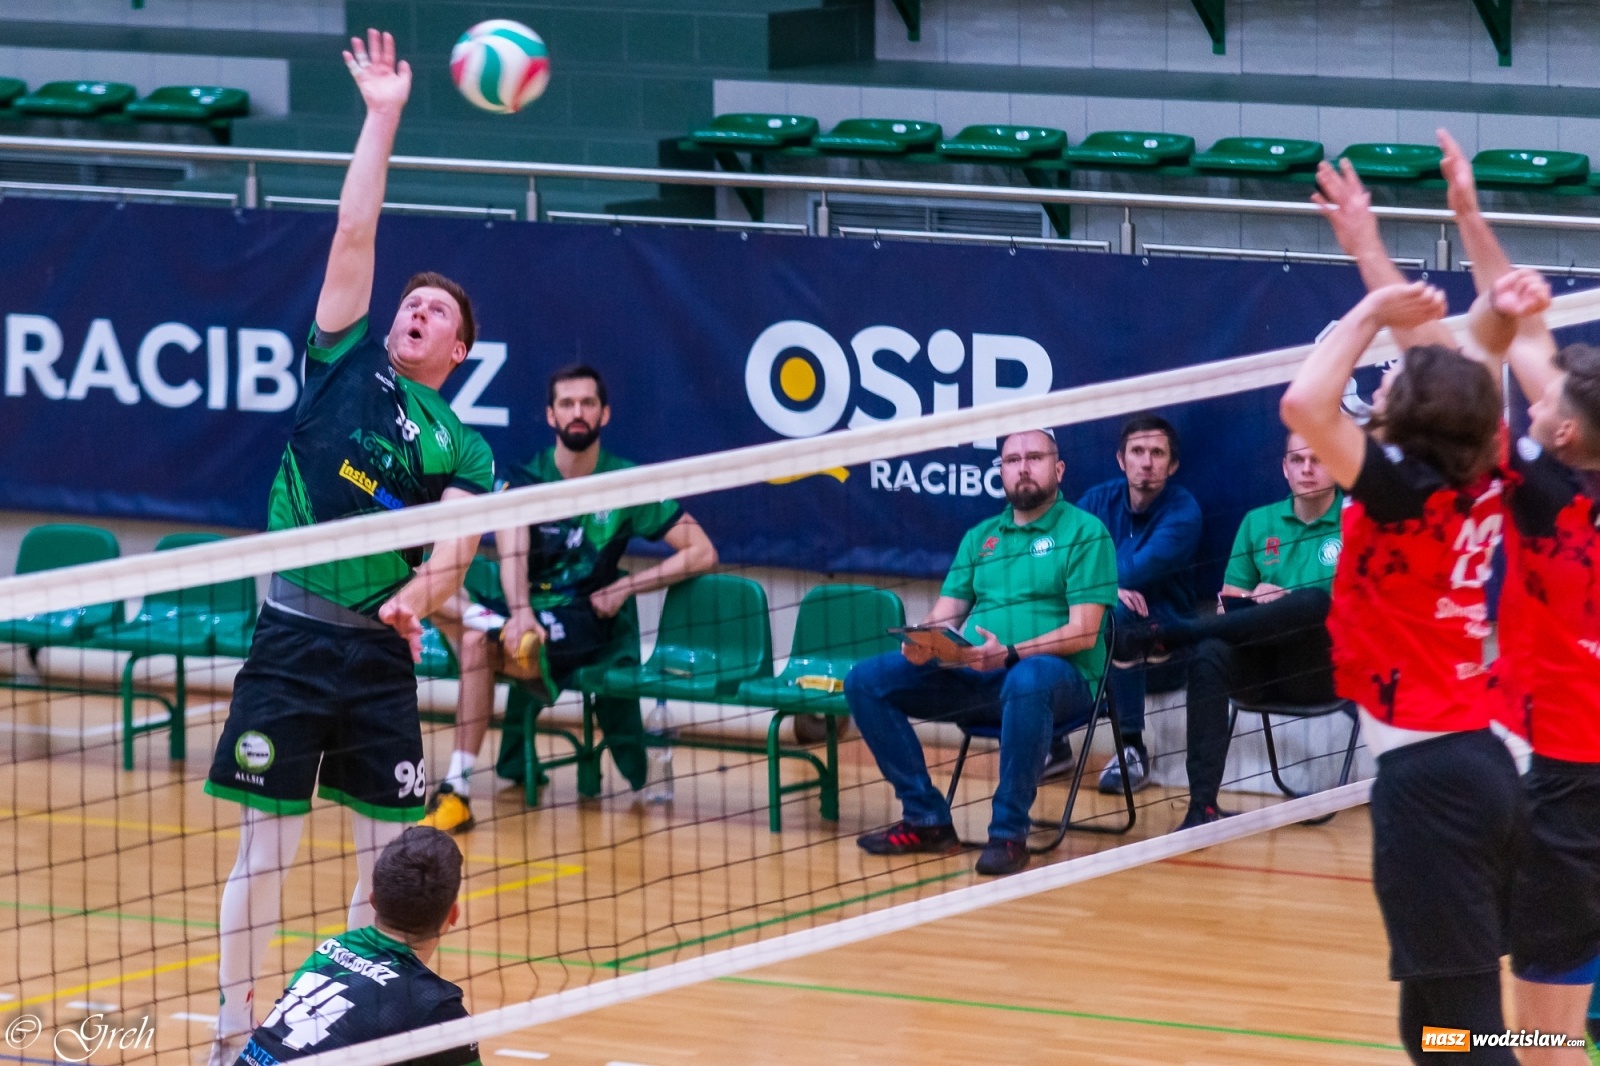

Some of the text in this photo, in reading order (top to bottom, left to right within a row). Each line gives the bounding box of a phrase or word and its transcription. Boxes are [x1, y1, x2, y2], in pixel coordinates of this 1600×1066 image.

[4, 313, 510, 427] RACIBZ
[745, 320, 1055, 450] OSiR
[869, 457, 1006, 499] RACIBÓ
[394, 758, 426, 798] 98
